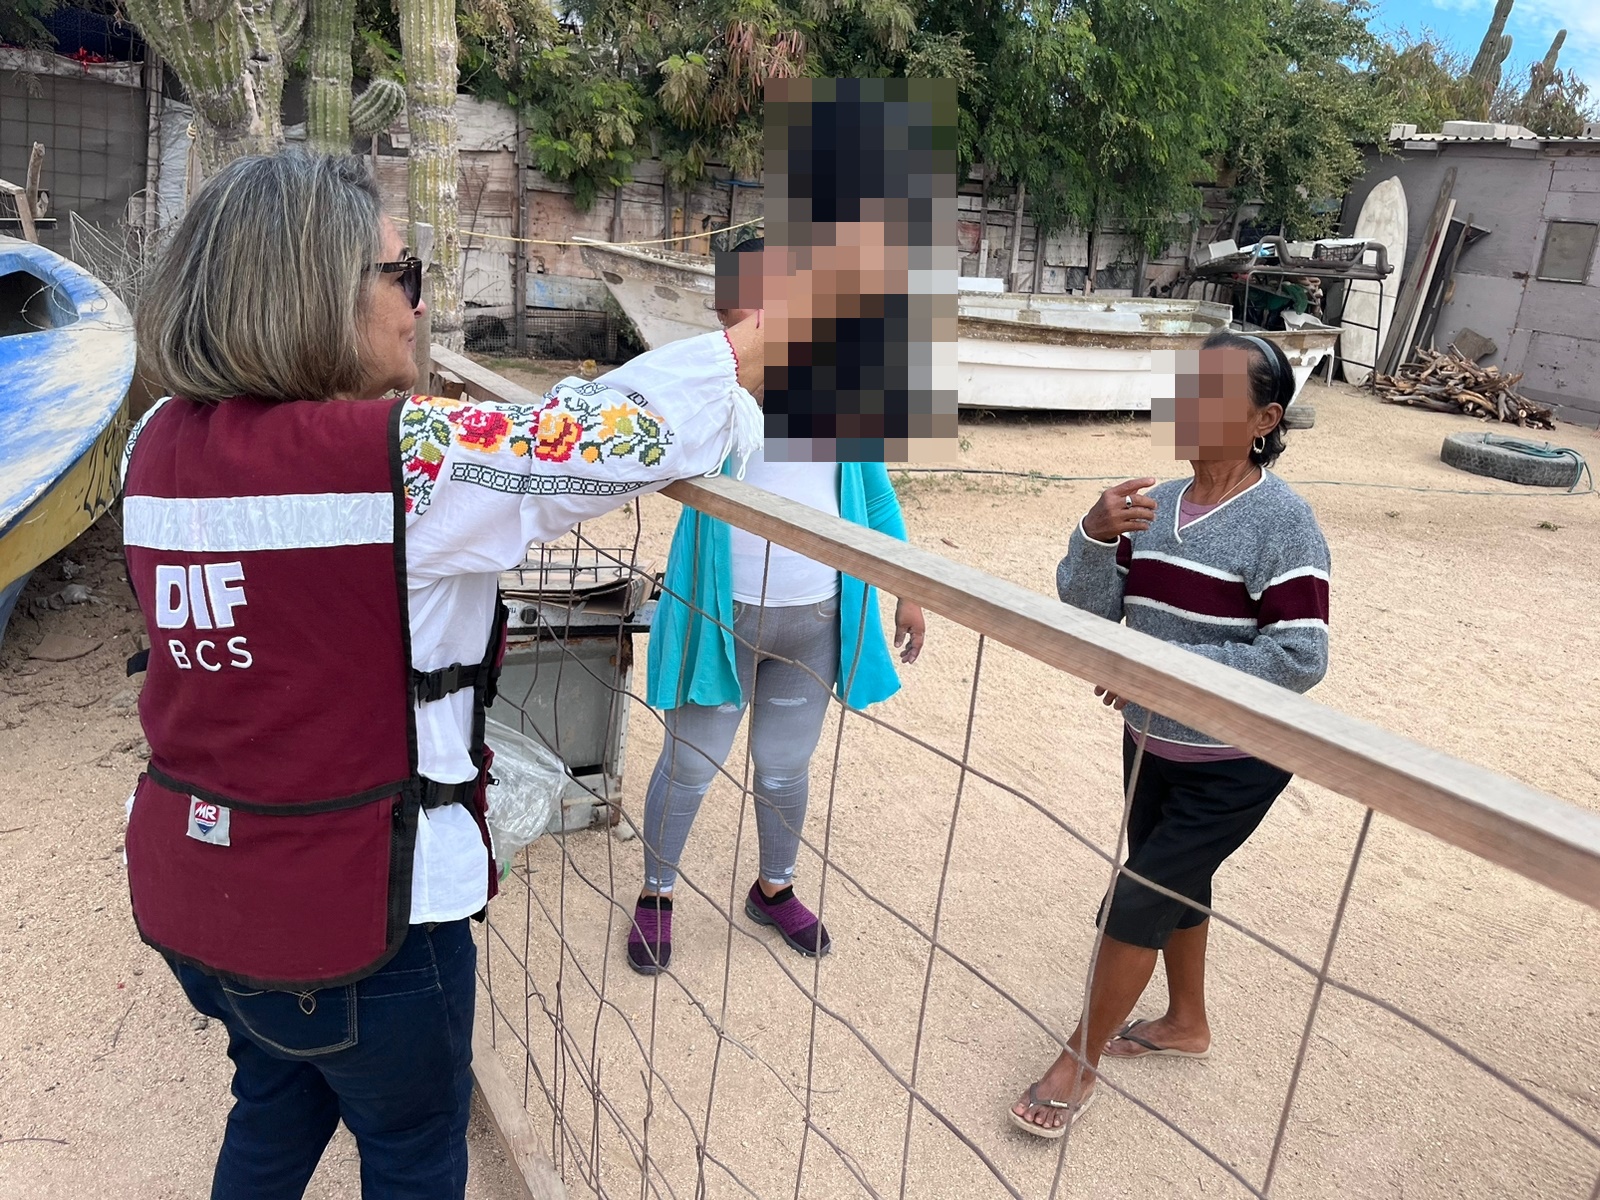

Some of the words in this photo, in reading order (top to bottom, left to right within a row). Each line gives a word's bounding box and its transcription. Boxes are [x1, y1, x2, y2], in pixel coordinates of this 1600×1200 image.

[156, 561, 247, 629] DIF
[168, 636, 253, 671] BCS
[195, 804, 217, 820] MR
